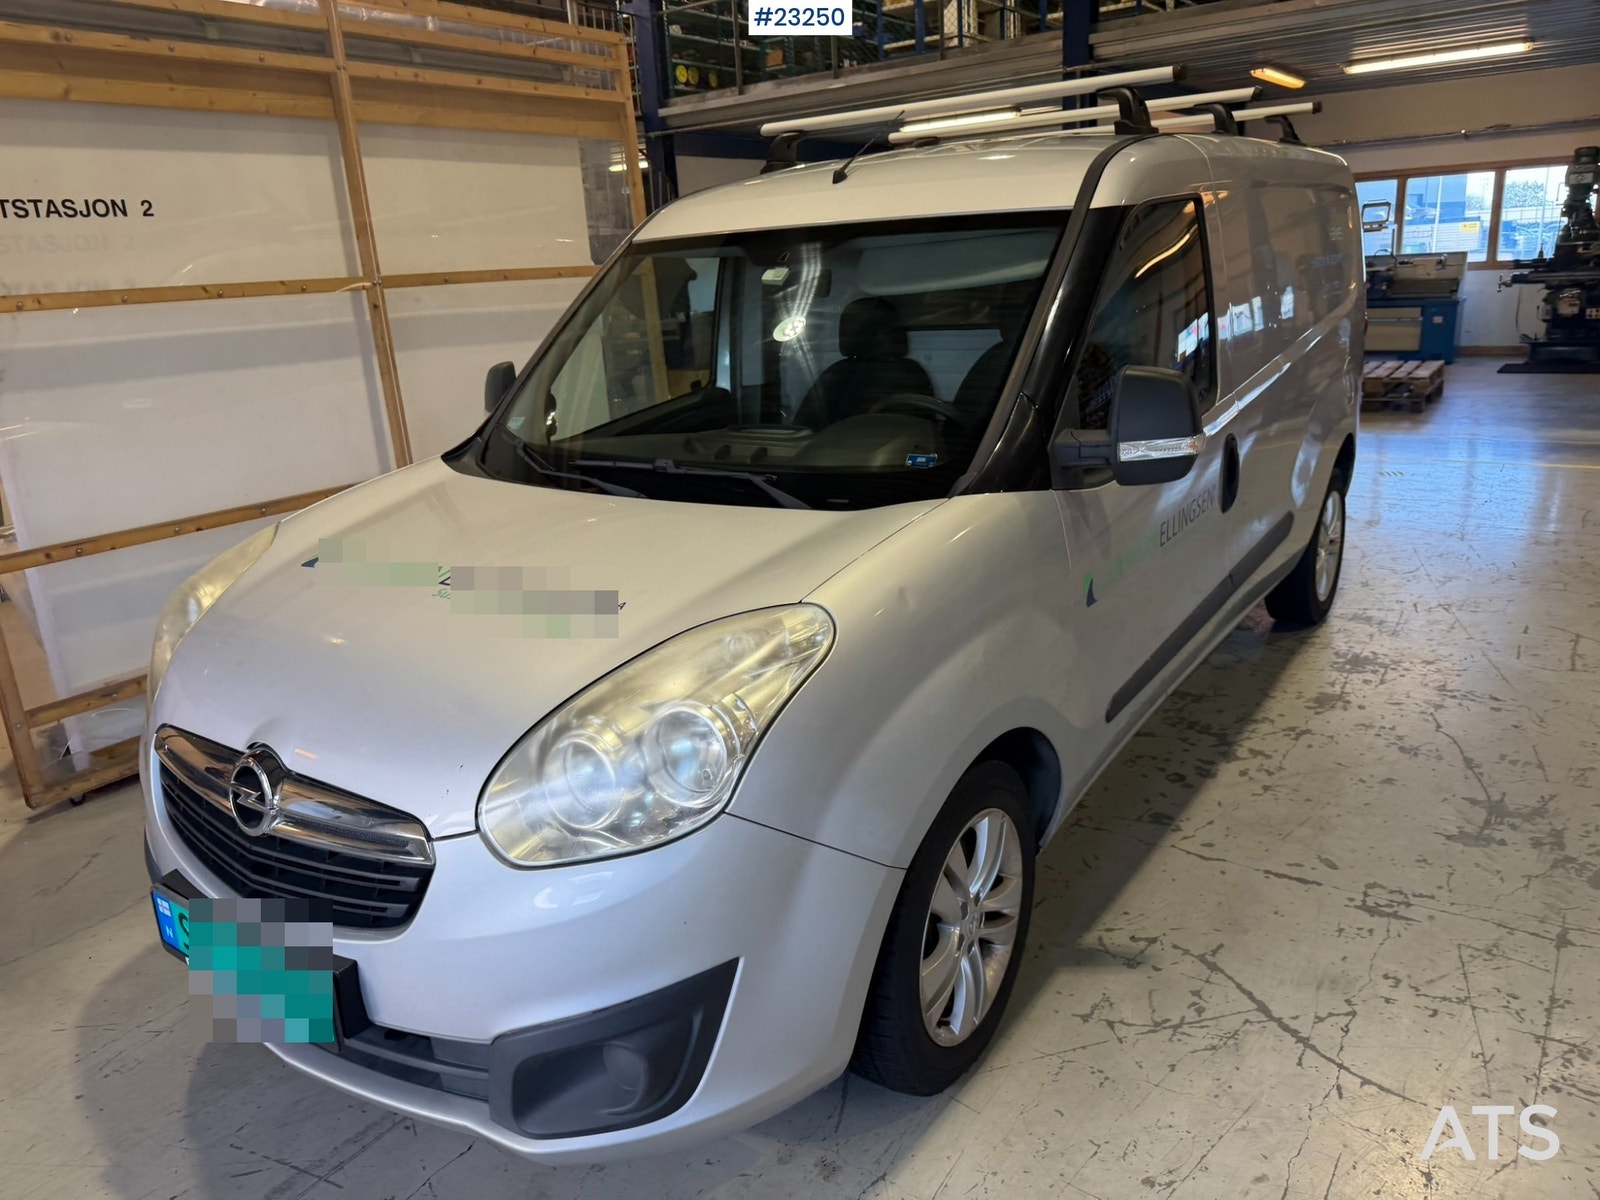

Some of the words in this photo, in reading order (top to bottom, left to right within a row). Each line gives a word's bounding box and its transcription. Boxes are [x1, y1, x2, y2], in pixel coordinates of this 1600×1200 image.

[140, 200, 155, 217] 2
[1160, 486, 1215, 547] ELLINGSEN
[165, 925, 174, 938] N
